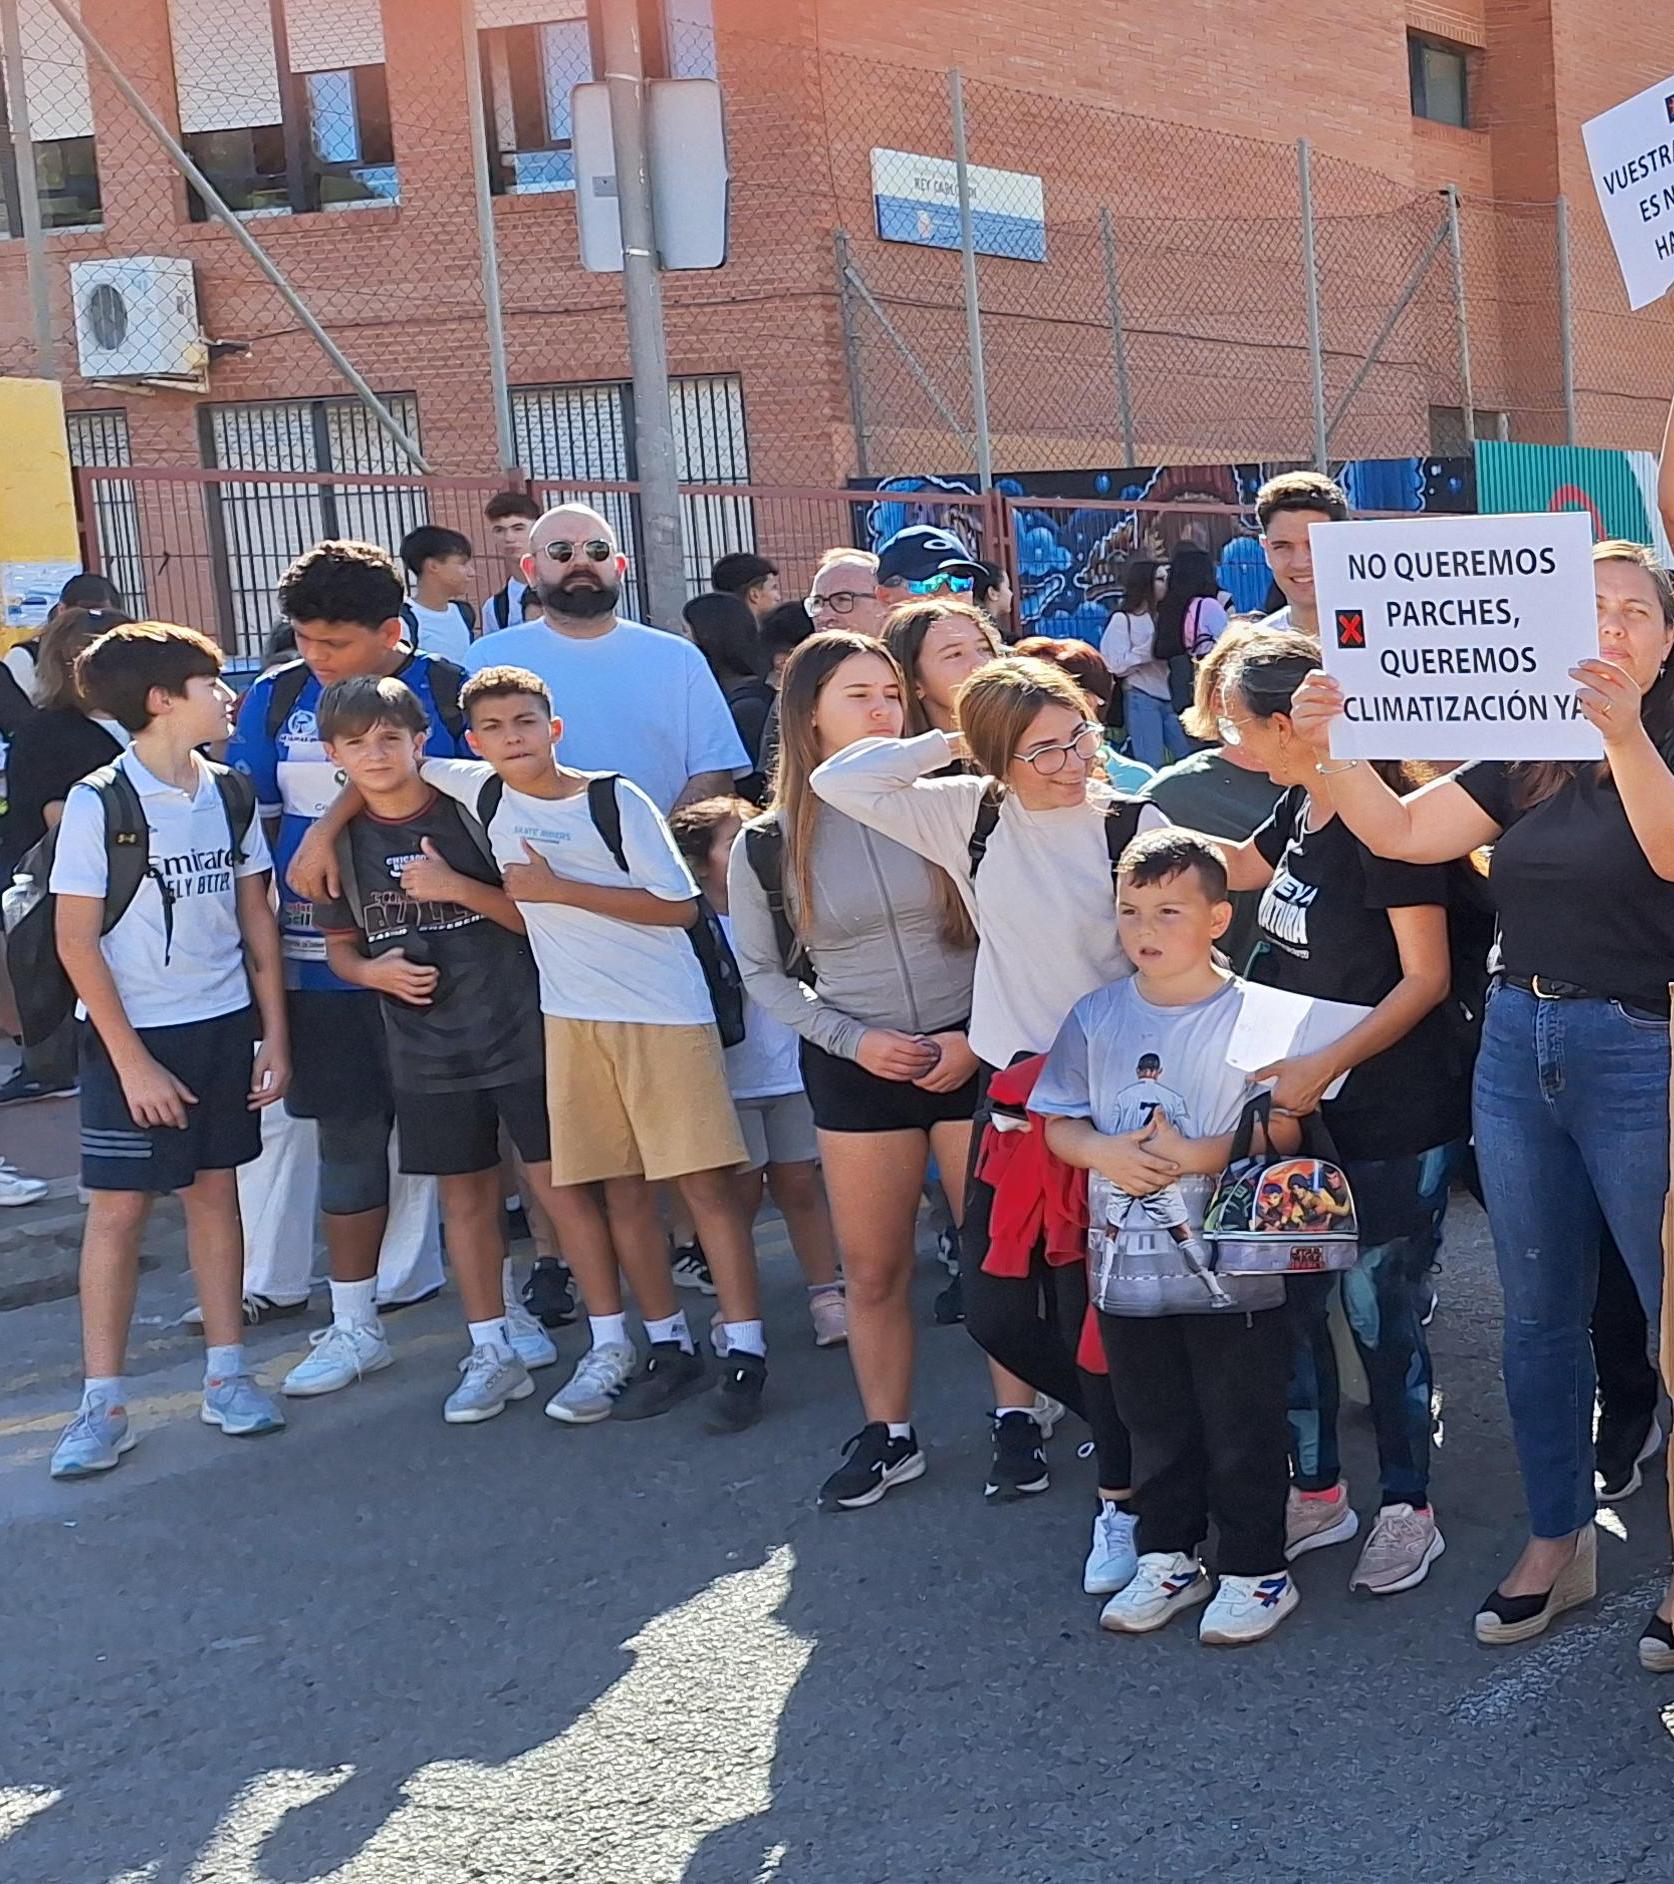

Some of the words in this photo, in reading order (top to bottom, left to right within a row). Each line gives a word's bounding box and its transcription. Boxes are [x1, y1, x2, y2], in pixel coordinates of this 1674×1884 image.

[1639, 194, 1661, 223] ES
[1348, 553, 1387, 580] NO
[1394, 547, 1556, 582] QUEREMOS
[1386, 598, 1520, 629] PARCHES,
[1380, 646, 1537, 678] QUEREMOS
[1343, 690, 1547, 722] CLIMATIZACIÓN
[1139, 1101, 1160, 1126] 7
